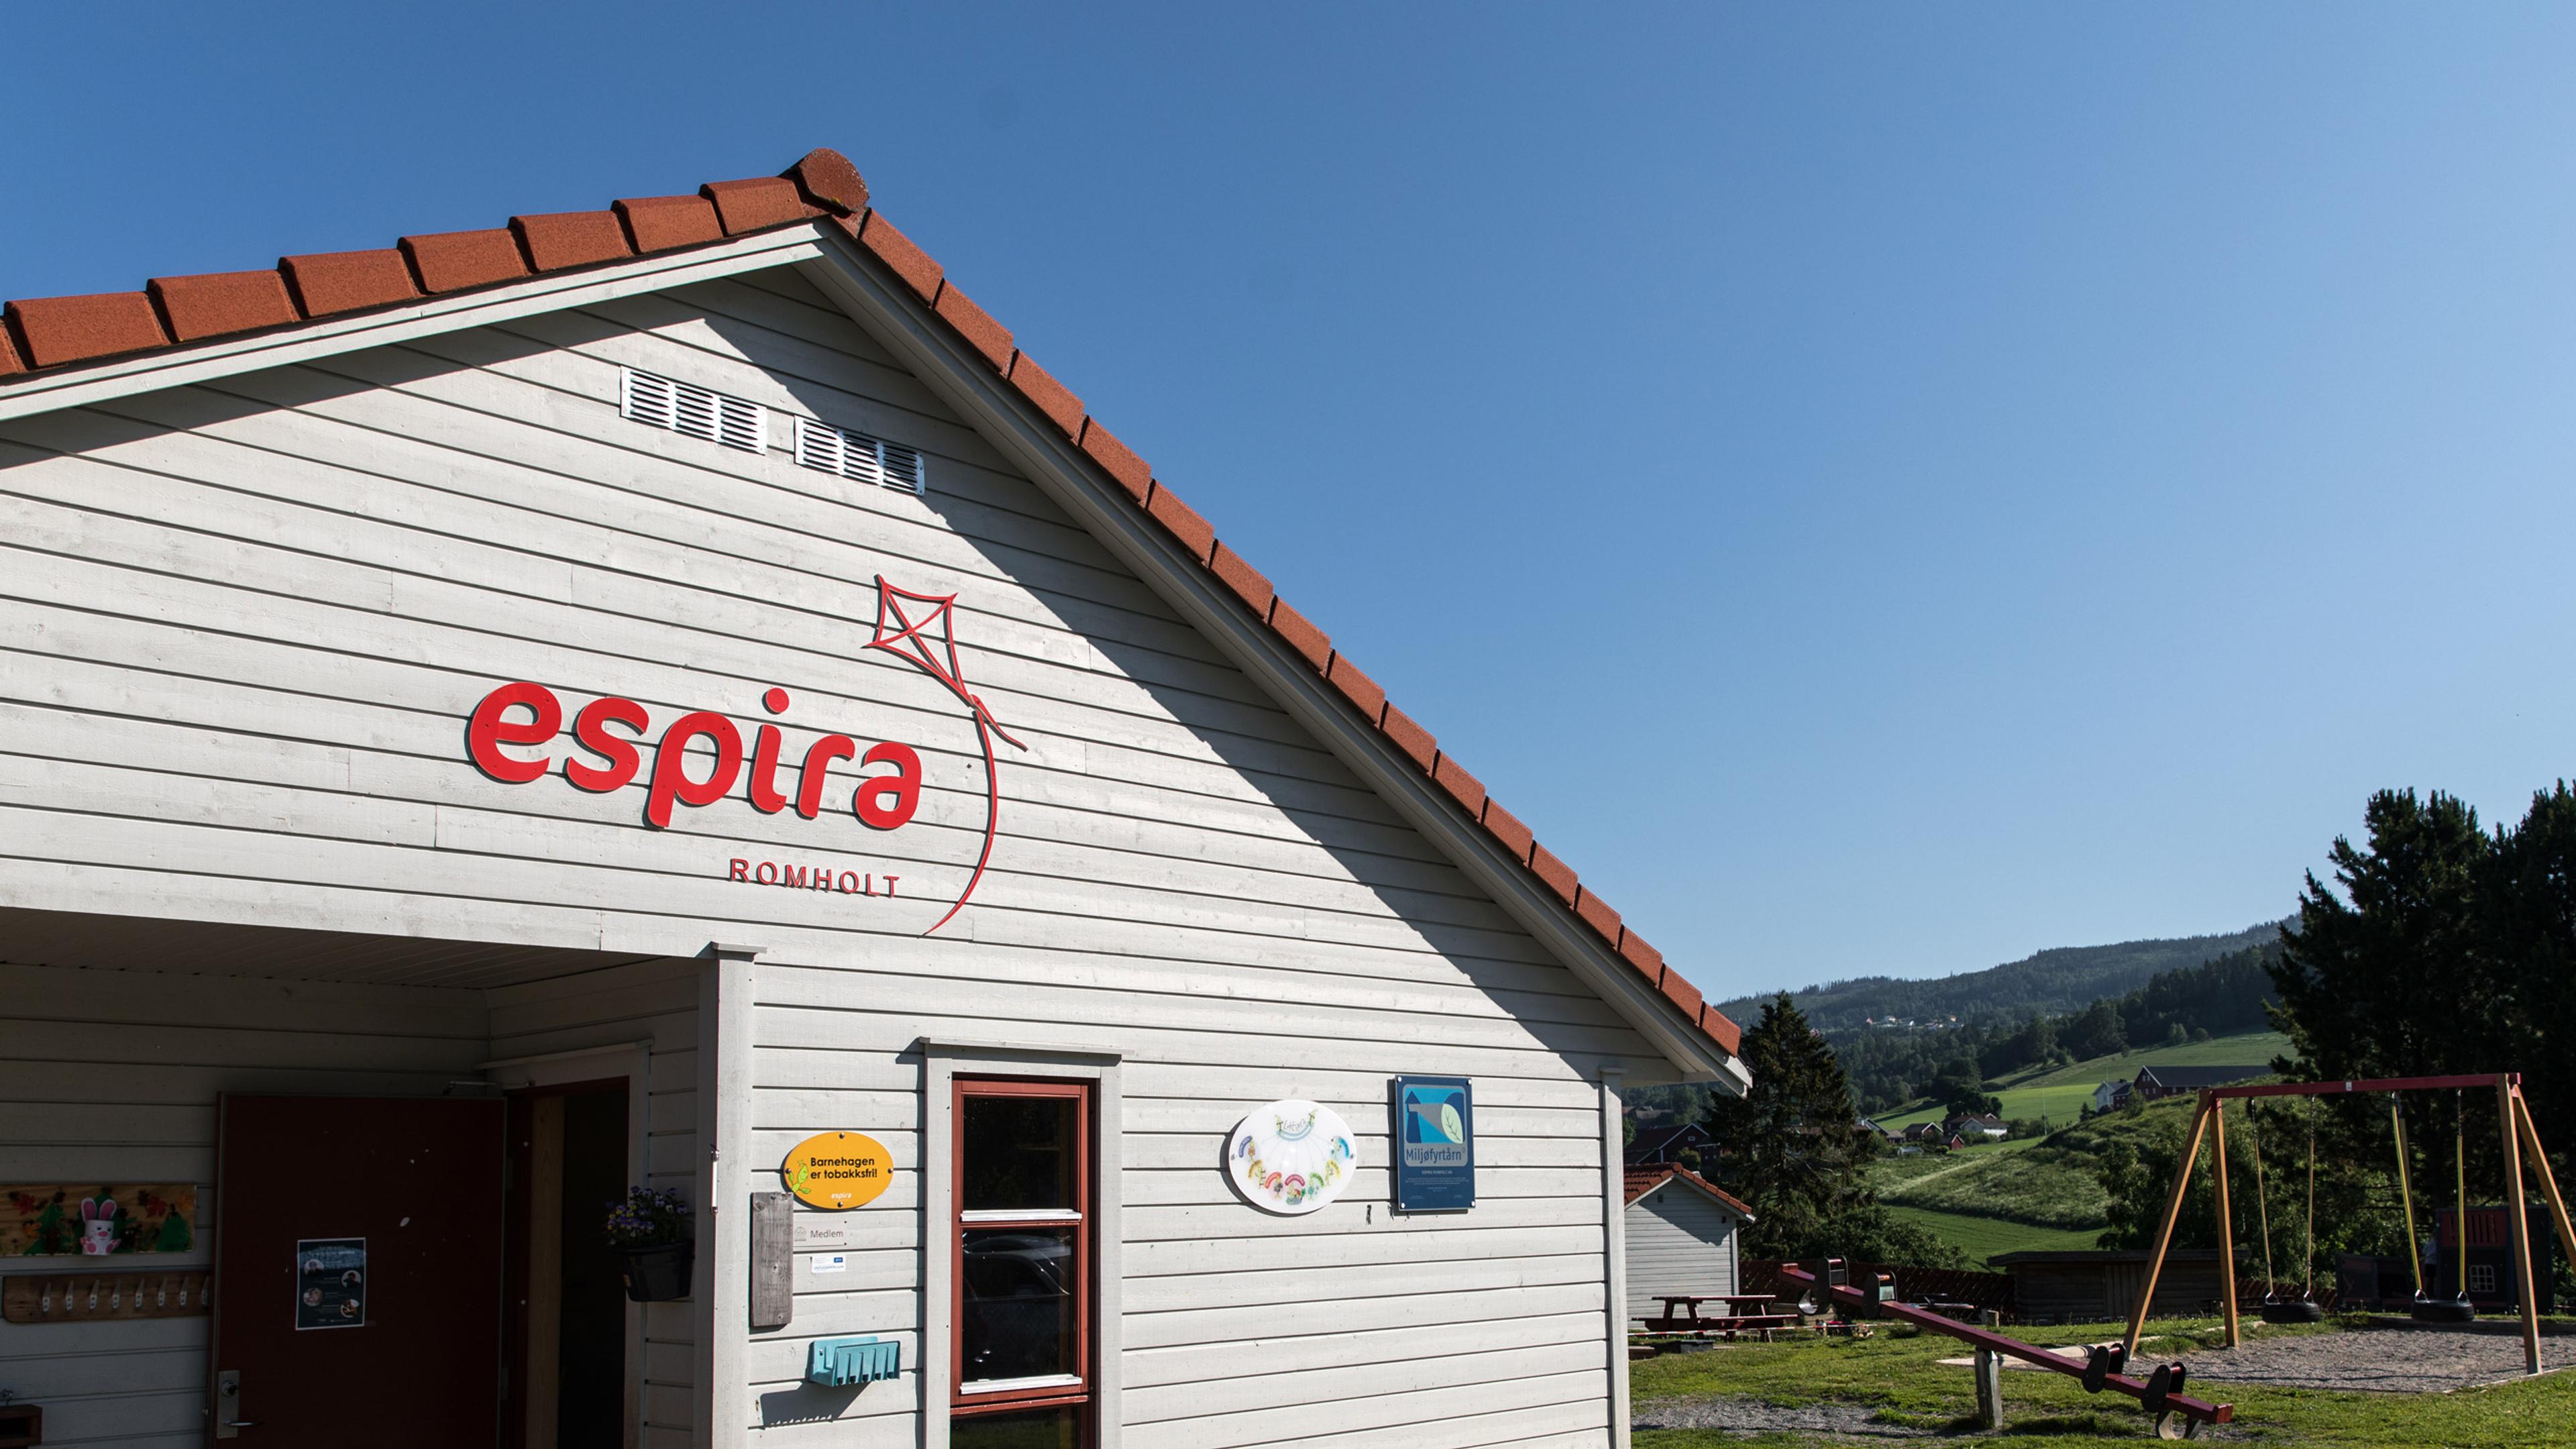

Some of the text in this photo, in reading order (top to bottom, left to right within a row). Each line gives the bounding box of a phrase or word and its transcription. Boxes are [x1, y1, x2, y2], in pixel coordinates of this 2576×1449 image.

[468, 682, 922, 829] espira
[731, 858, 900, 897] ROMHOLT
[1406, 1147, 1461, 1163] Miljøfyrtårn
[810, 1157, 875, 1168] Barnehagen
[824, 1169, 877, 1179] tobakksfri!
[810, 1229, 843, 1238] Medlem
